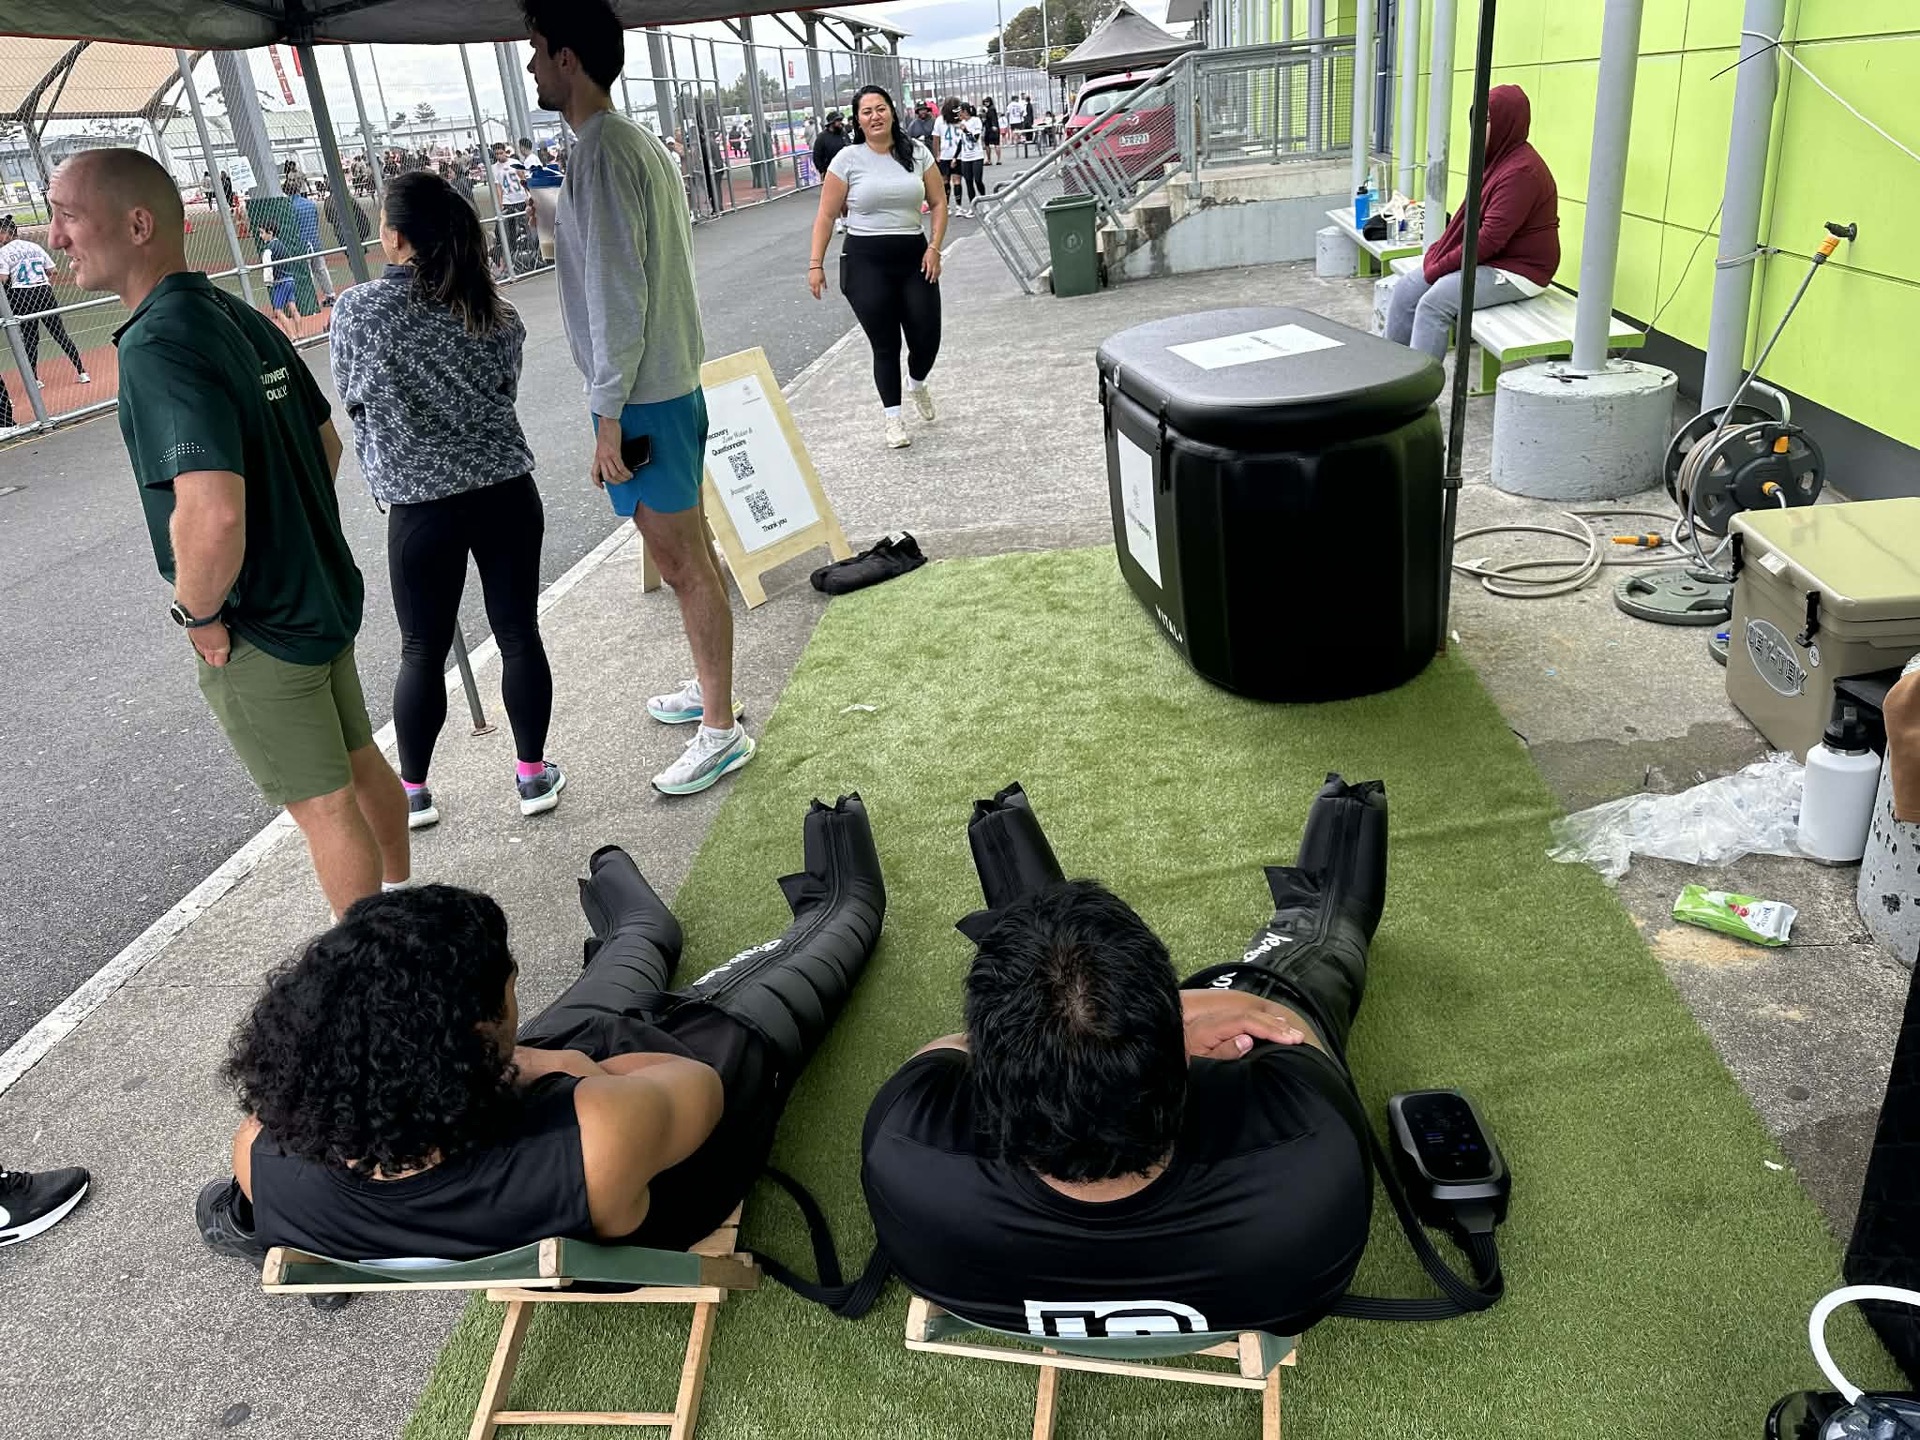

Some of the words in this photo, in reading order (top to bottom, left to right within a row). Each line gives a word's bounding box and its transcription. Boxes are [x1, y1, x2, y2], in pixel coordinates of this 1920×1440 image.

[707, 428, 728, 441] ecovery
[762, 521, 778, 532] Thank
[778, 518, 788, 527] you
